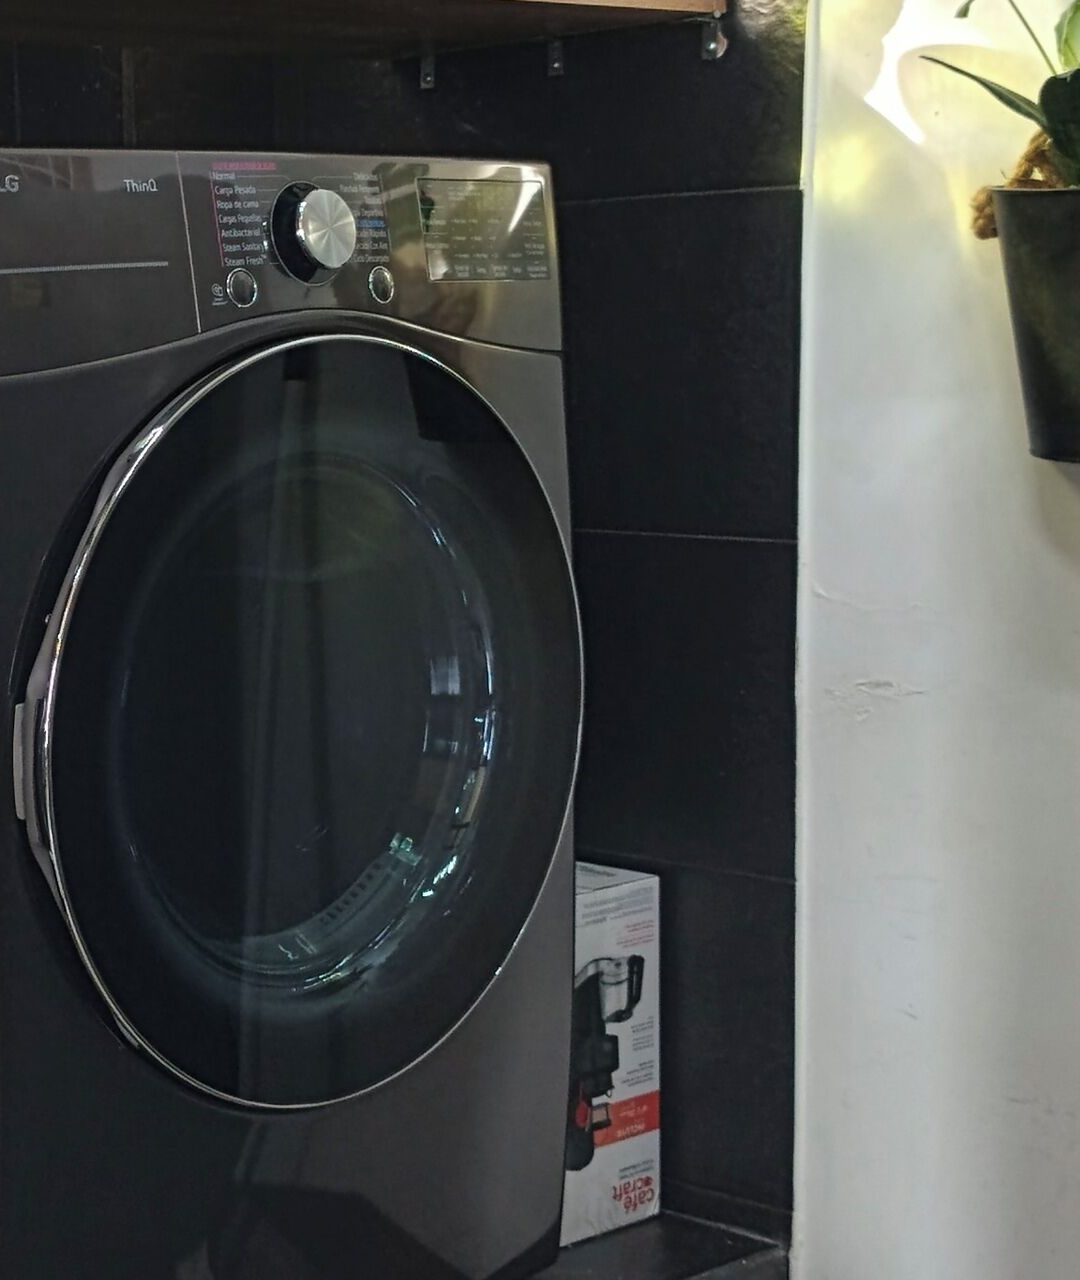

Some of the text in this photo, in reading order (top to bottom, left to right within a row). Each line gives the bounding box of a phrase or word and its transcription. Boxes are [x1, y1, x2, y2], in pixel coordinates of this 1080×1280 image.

[124, 178, 158, 192] ThinQ
[225, 257, 245, 266] Steam
[612, 1177, 644, 1201] craft
[623, 1188, 654, 1214] café
